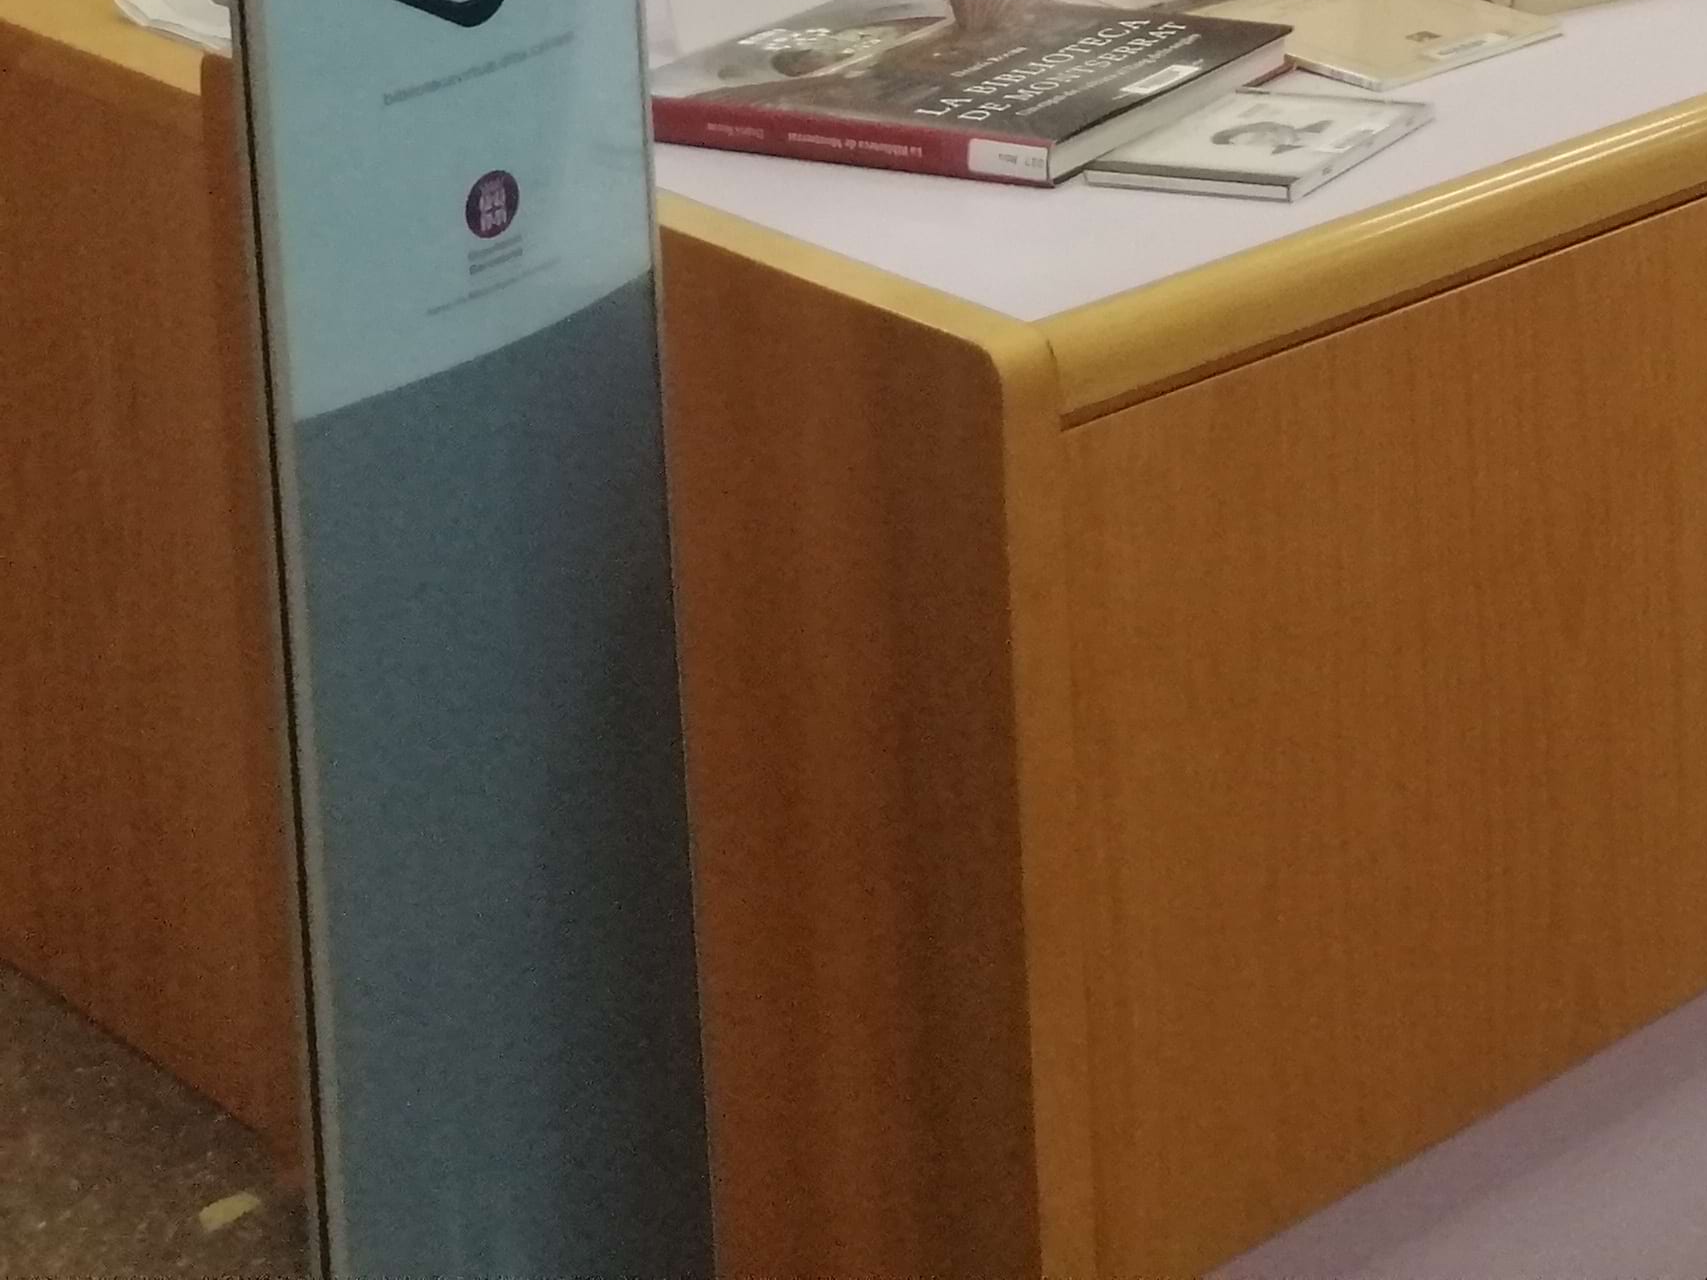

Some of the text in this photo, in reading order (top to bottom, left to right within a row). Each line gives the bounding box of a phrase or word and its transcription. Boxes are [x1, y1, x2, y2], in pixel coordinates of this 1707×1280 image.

[916, 96, 972, 117] LA
[967, 18, 1151, 95] BIBLIOTECA
[958, 101, 1011, 122] DE
[1005, 21, 1188, 103] MONTSERRAT
